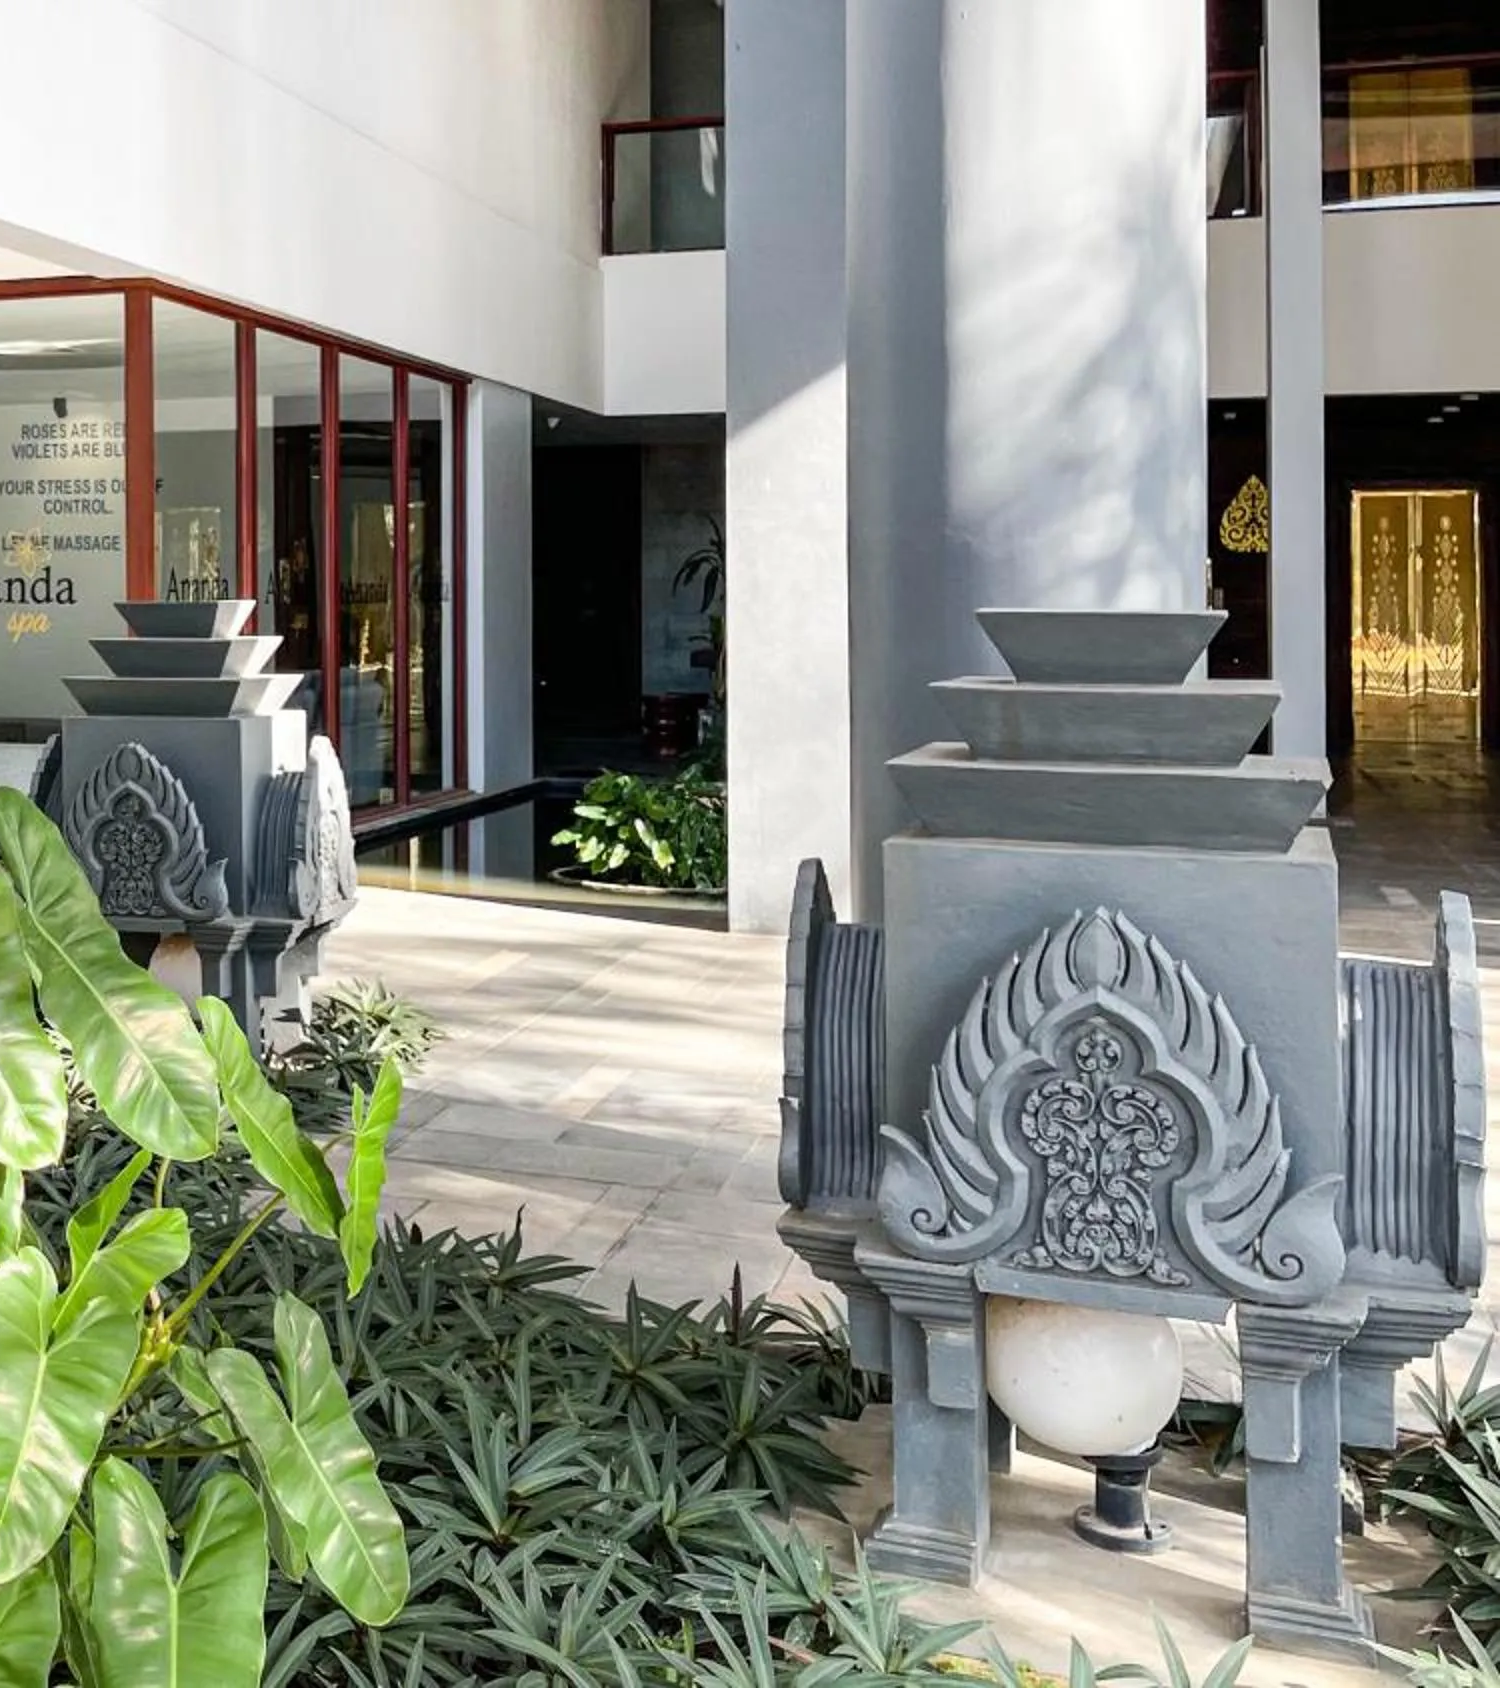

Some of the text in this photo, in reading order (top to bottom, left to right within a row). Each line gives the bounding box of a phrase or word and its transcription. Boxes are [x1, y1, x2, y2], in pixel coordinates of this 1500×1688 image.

[21, 422, 127, 441] ROSES ARE RE
[11, 442, 127, 460] VIOLETS ARE BL
[37, 478, 92, 495] STRESS
[94, 478, 107, 494] IS
[53, 534, 121, 552] MASSAGE
[7, 611, 51, 644] spa
